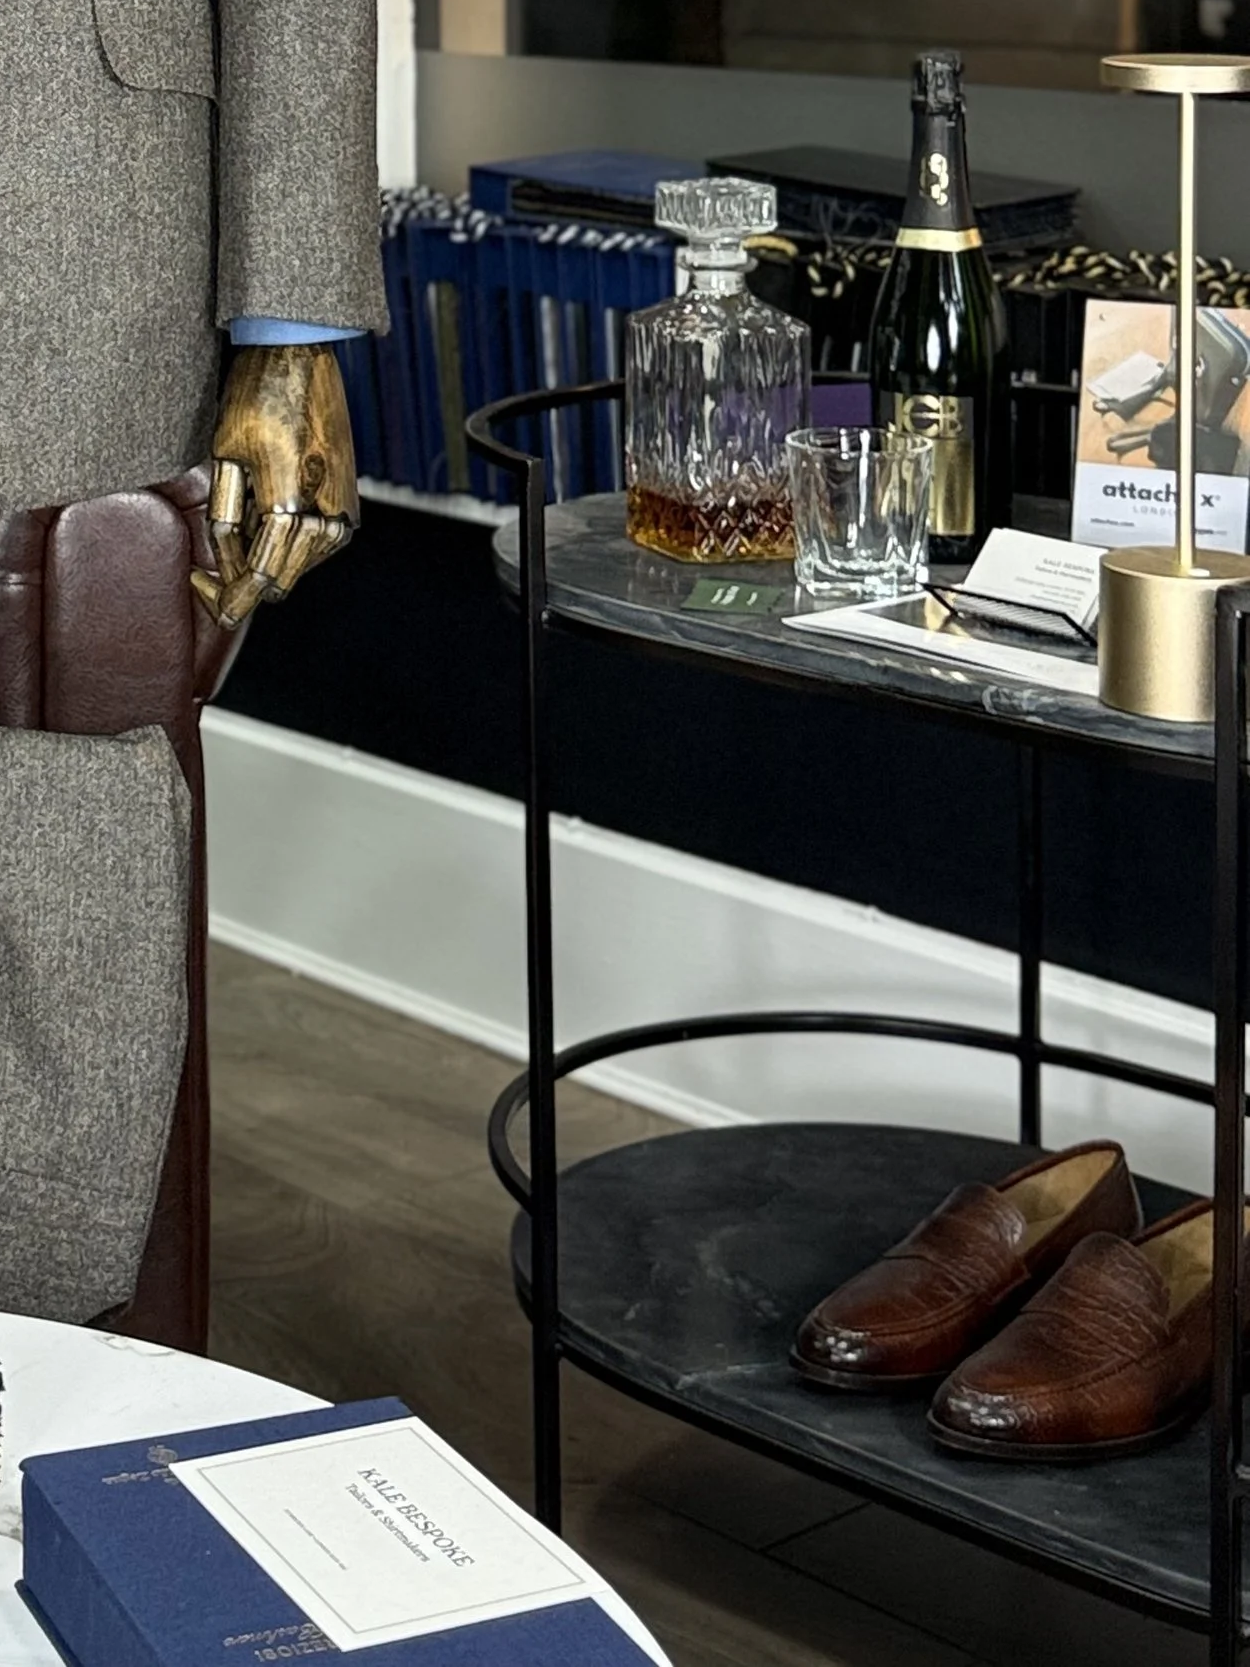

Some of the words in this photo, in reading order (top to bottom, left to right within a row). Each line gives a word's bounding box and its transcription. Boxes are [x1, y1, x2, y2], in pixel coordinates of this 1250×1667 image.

[1102, 481, 1215, 508] attachx
[356, 1468, 407, 1504] KALE
[396, 1504, 476, 1567] BESPOKE
